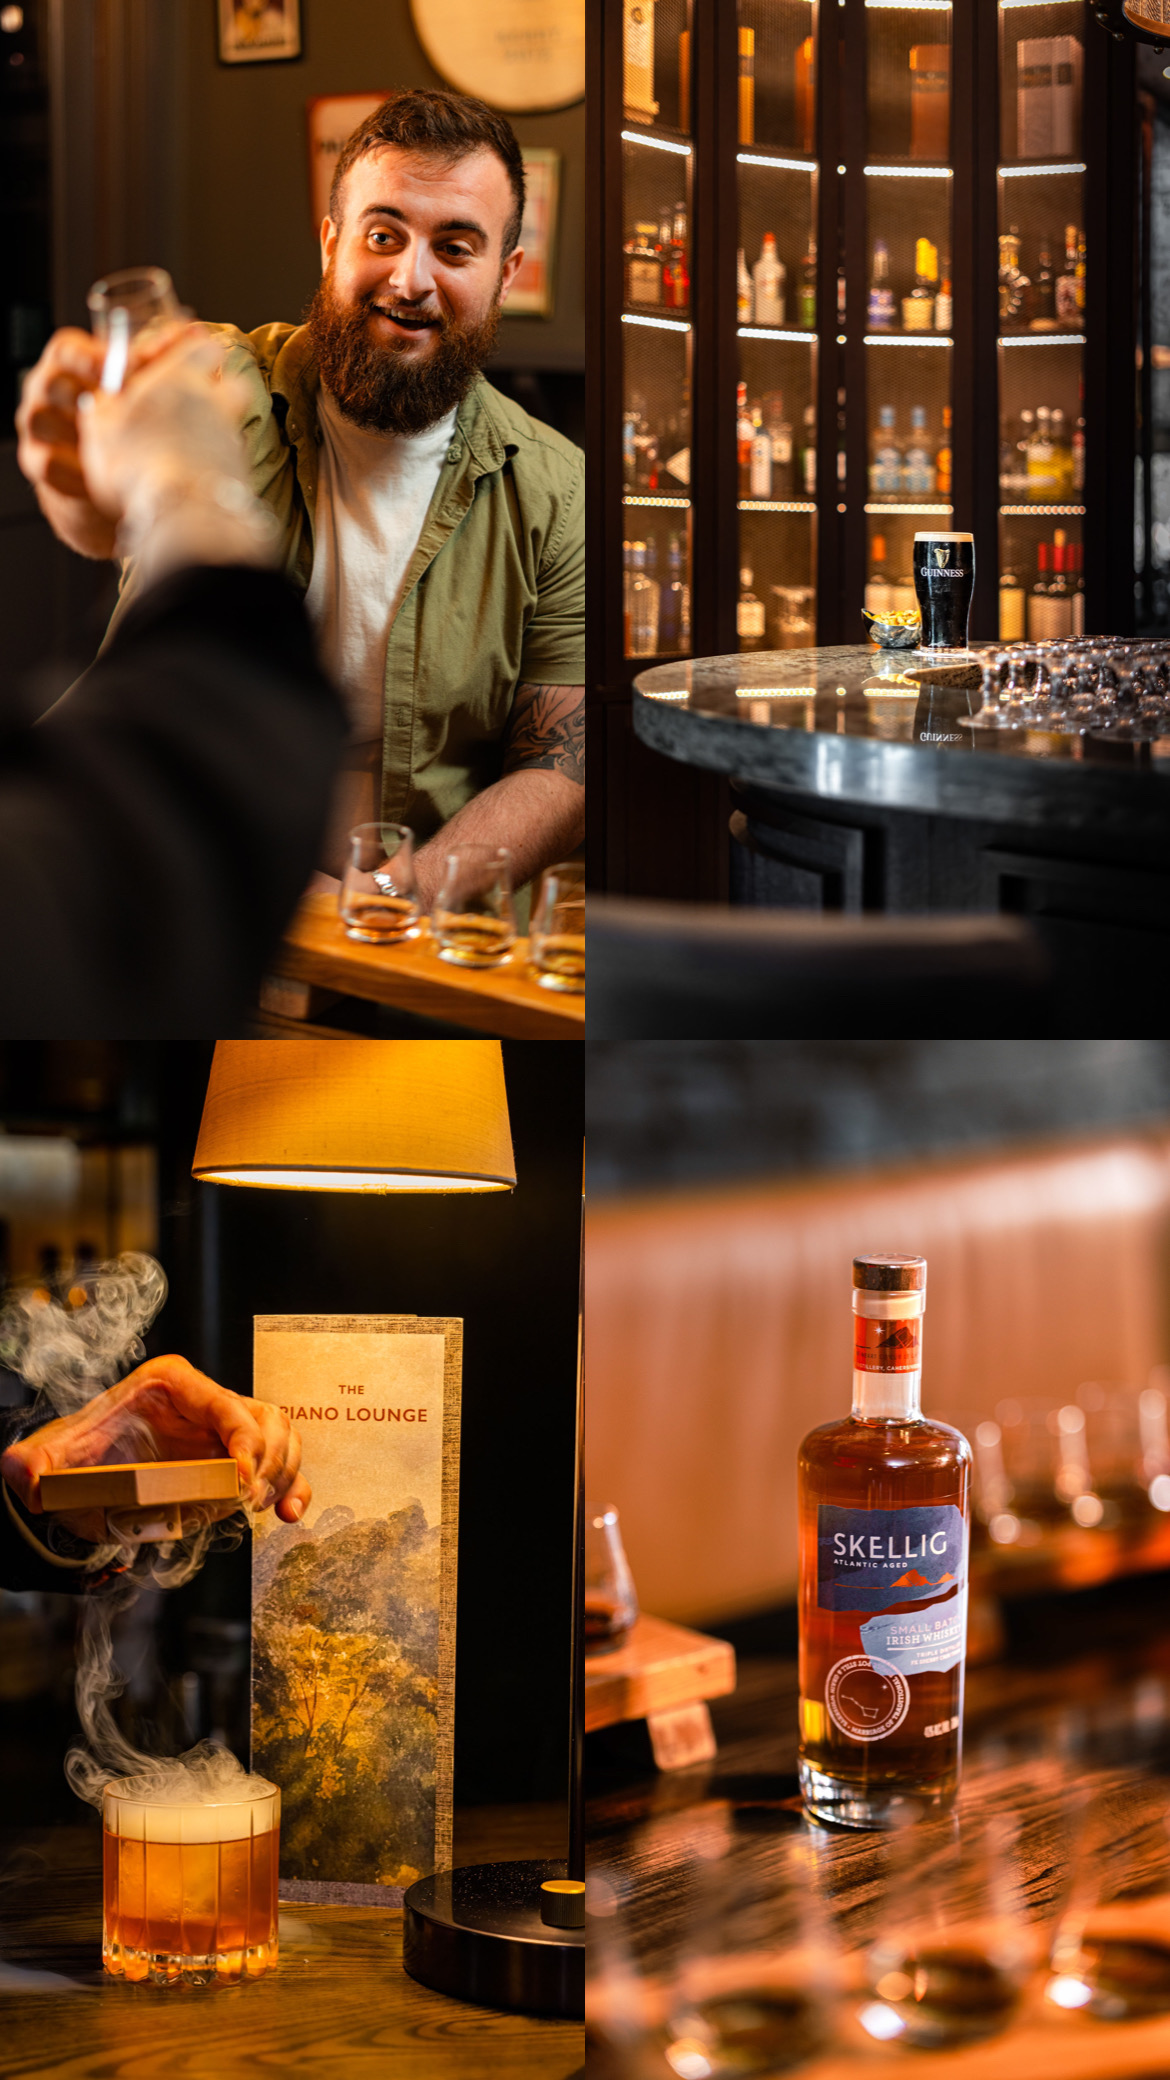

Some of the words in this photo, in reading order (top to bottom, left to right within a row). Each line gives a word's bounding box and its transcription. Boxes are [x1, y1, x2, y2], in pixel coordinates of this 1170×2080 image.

[920, 566, 964, 577] GUINNESS
[338, 1384, 365, 1395] THE
[346, 1407, 428, 1422] LOUNGE
[833, 1531, 947, 1559] SKELLIG
[833, 1559, 878, 1568] ATLANTIC
[890, 1624, 931, 1635] SMALL
[886, 1634, 921, 1645] IRISH
